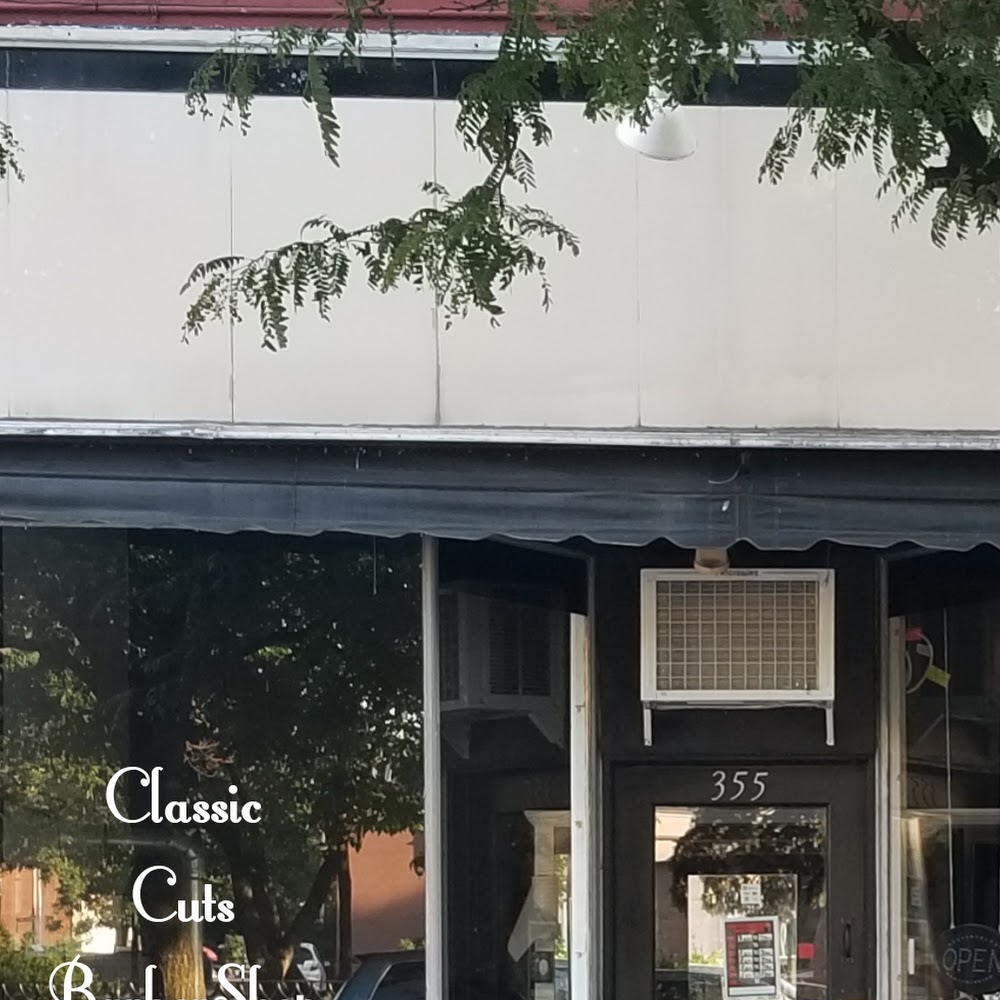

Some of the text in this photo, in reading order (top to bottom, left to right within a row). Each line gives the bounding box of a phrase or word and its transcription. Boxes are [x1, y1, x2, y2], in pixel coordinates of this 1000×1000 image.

[106, 766, 262, 823] Classic
[711, 770, 769, 801] 355
[132, 865, 235, 923] Cuts
